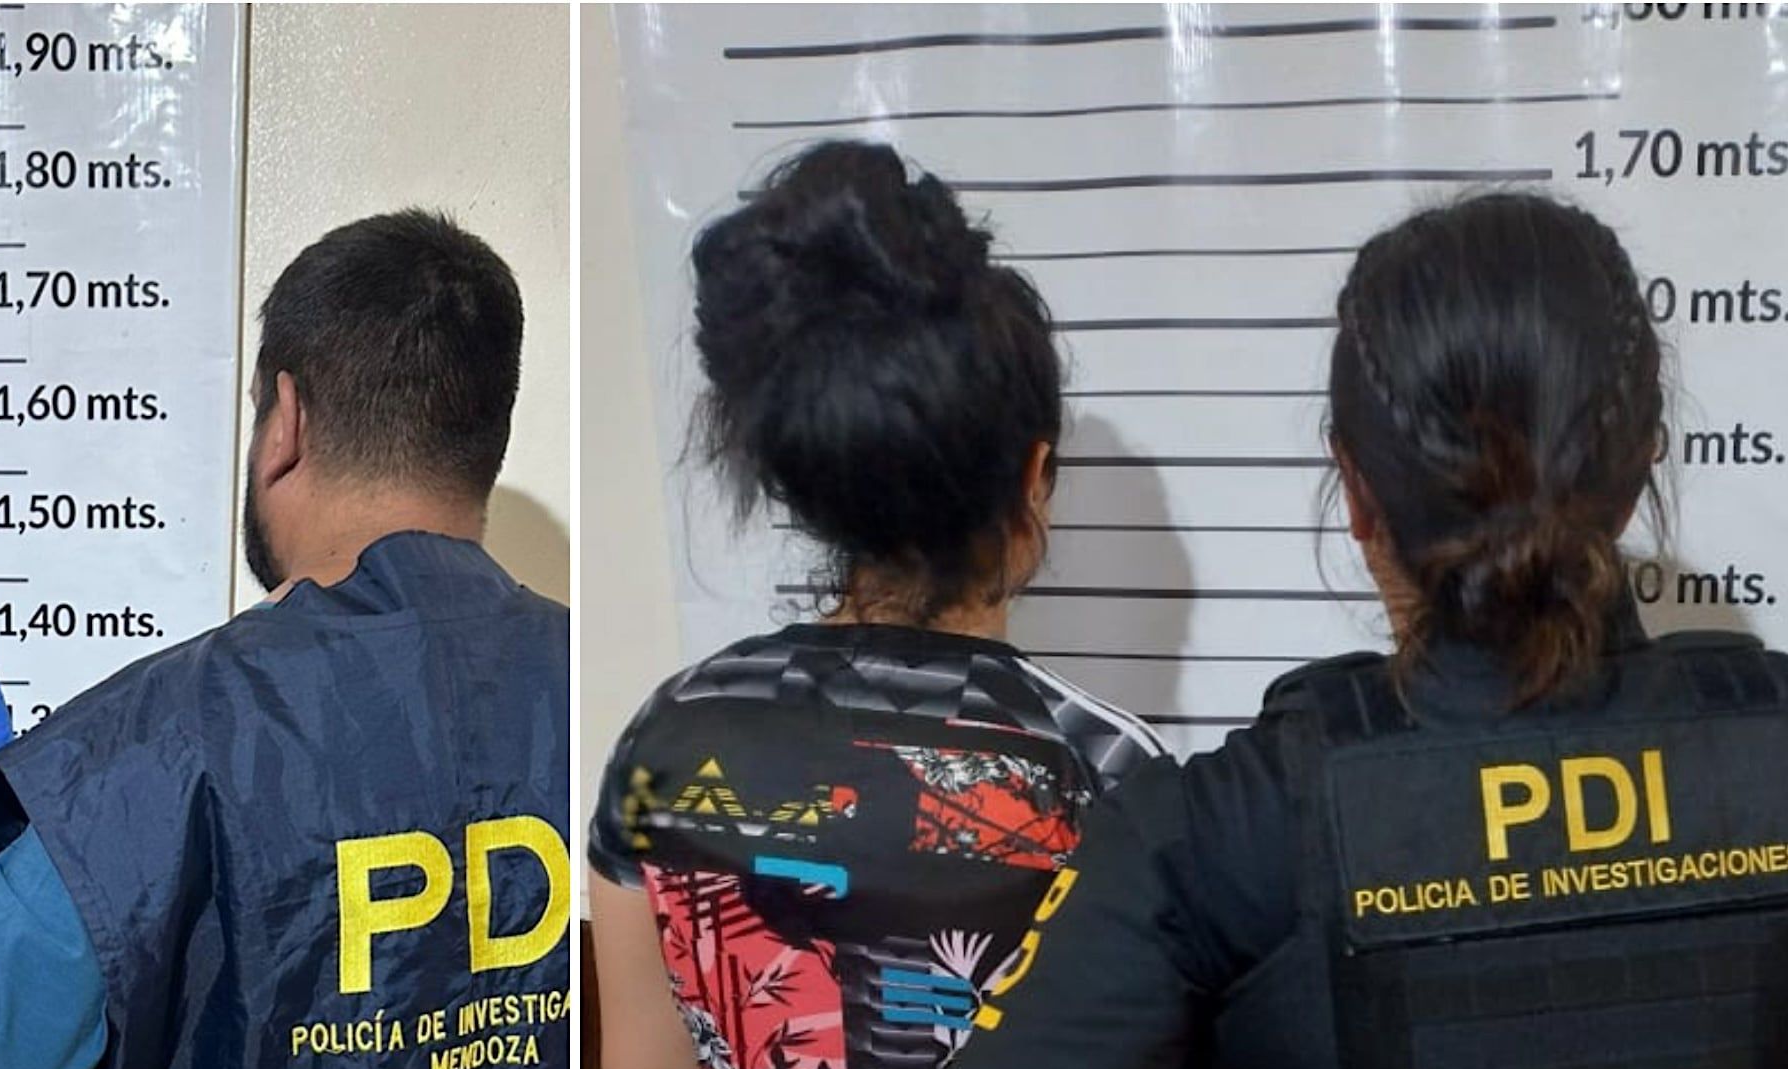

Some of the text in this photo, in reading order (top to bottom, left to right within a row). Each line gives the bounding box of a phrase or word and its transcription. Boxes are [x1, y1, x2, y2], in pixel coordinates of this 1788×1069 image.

[88, 34, 173, 71] mts.
[88, 153, 171, 188] mts.
[1576, 129, 1683, 186] 1,70
[87, 274, 169, 308] mts.
[87, 387, 167, 420] mts.
[1683, 424, 1785, 465] mts.
[86, 497, 165, 528] mts.
[1677, 565, 1777, 605] mts.
[86, 607, 163, 637] mts.
[1479, 748, 1670, 861] PDI
[1355, 844, 1788, 917] POLICIA DE INVESTIGACIONE
[292, 1009, 404, 1056] POLICÍA
[417, 1010, 446, 1044] DE
